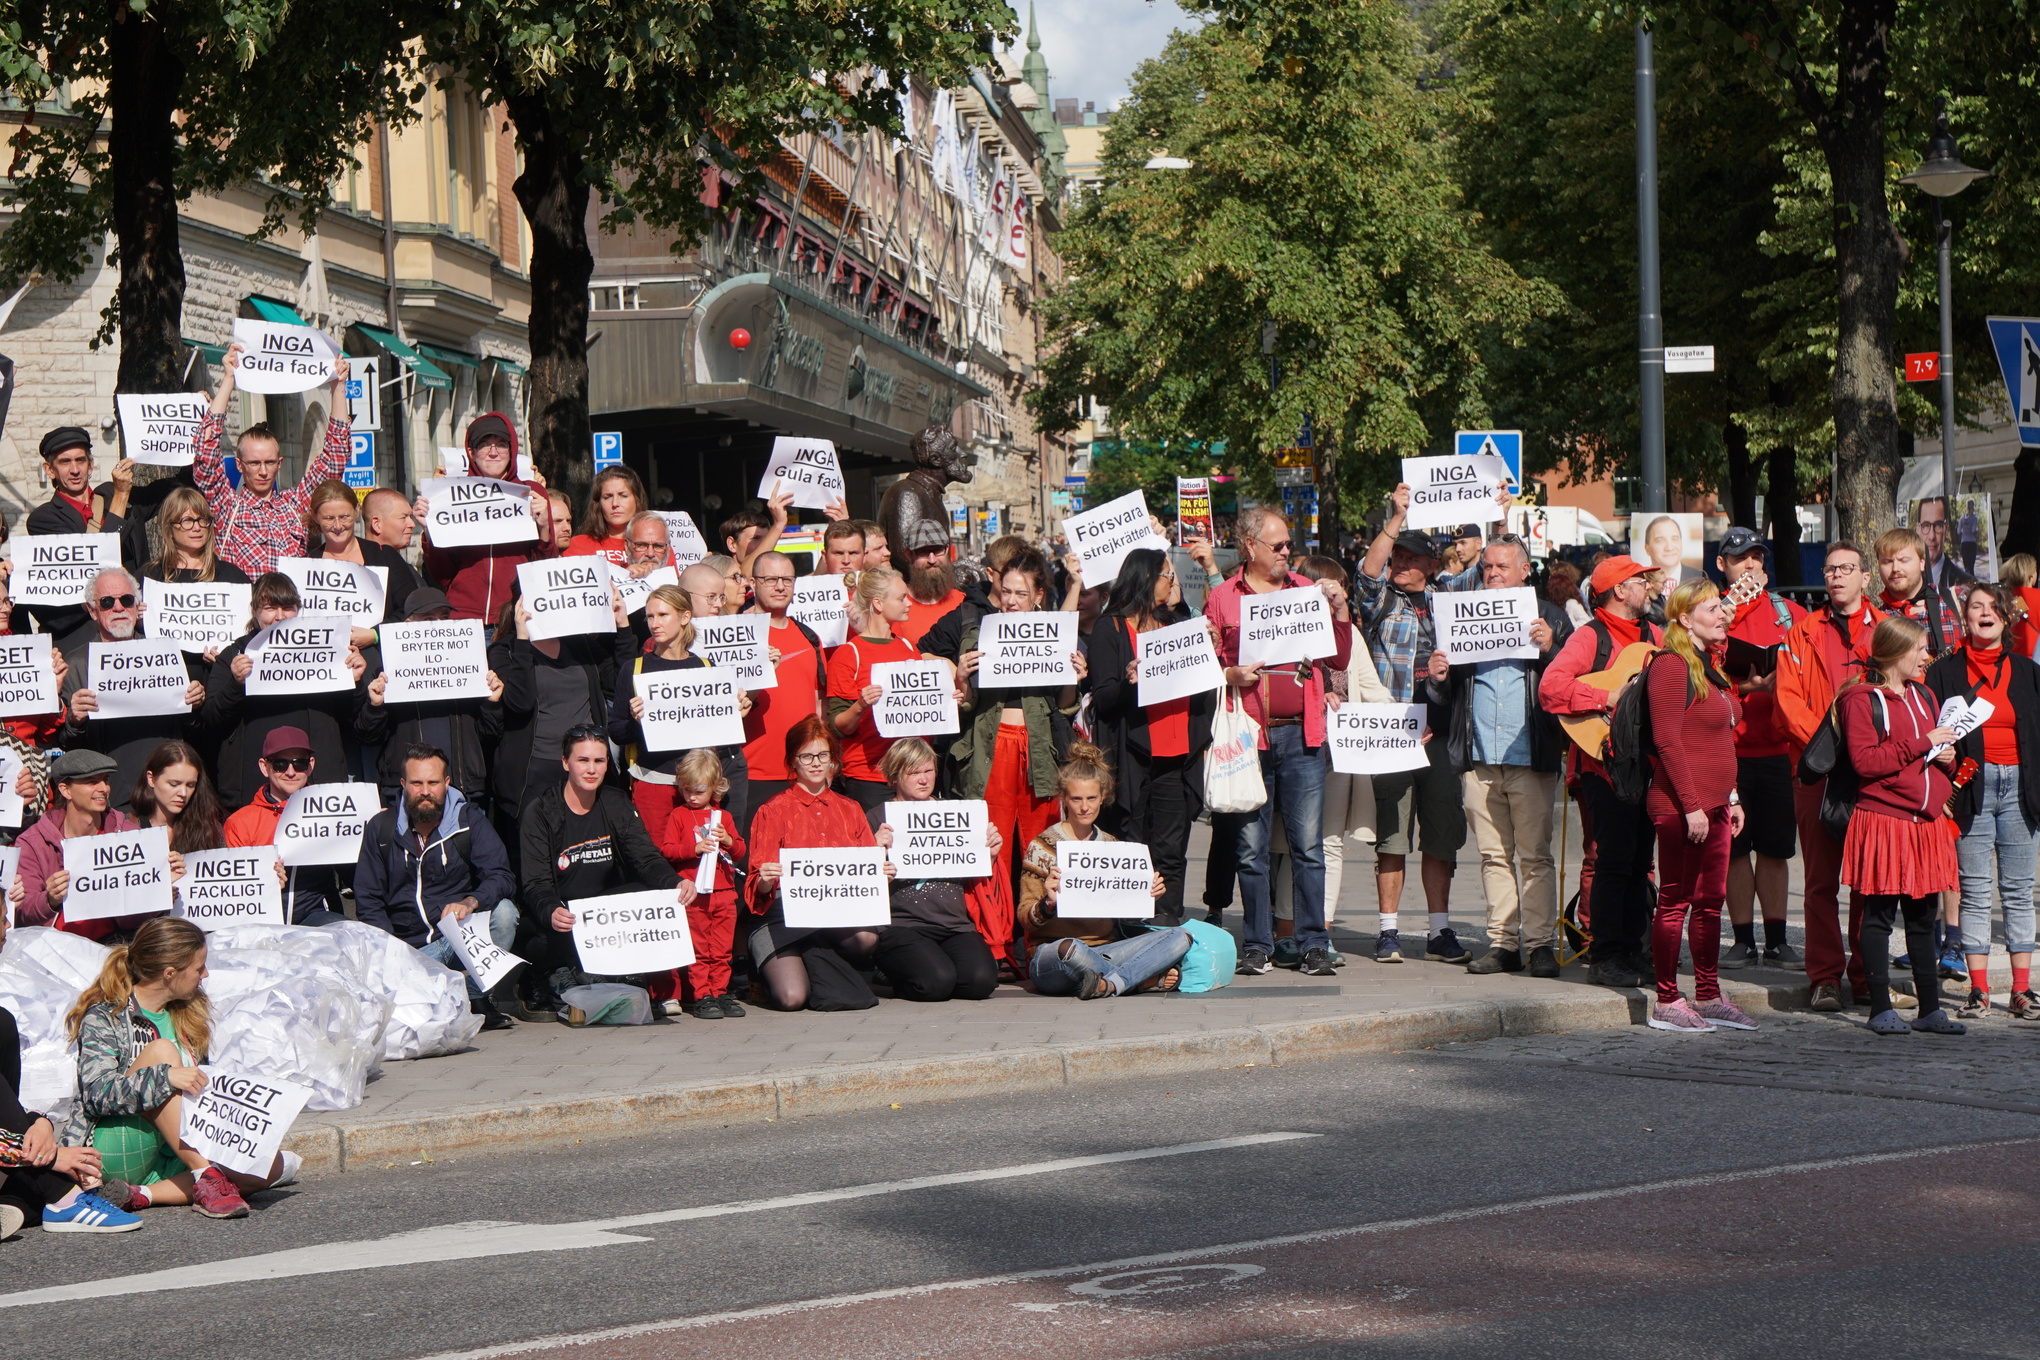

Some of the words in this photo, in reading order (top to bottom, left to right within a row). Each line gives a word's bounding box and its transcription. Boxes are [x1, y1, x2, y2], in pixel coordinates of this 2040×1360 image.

[262, 333, 314, 353] INGA
[1667, 350, 1705, 359] Vasagatan
[242, 355, 284, 374] Gula
[290, 358, 329, 377] fack
[1914, 359, 1934, 374] 7.9
[141, 404, 205, 419] INGEN
[147, 424, 198, 437] AVTALS
[140, 439, 196, 454] SHOPPI
[794, 449, 835, 467] INGA
[348, 471, 370, 480] Avgift
[774, 465, 813, 484] Gula
[817, 472, 842, 490] fack
[1430, 465, 1477, 482] INGA
[451, 482, 505, 502] INGA
[1414, 488, 1451, 504] Gula
[1457, 485, 1492, 500] fack
[435, 510, 478, 526] Gula
[484, 504, 524, 522] fack
[1075, 504, 1144, 542] Försvara
[1082, 524, 1151, 560] strejkrätten
[33, 545, 98, 563] INGET
[306, 571, 357, 588] INGA
[548, 568, 597, 587] INGA
[26, 585, 84, 596] MONOP
[791, 590, 841, 604] rsvara
[164, 594, 230, 608] INGET
[300, 597, 329, 610] ula
[335, 597, 373, 613] fack
[533, 597, 577, 612] Gula
[582, 593, 610, 608] fack
[1454, 599, 1517, 618] INGET
[1250, 600, 1320, 620] Försvara
[159, 613, 236, 626] FACKLIGT
[159, 628, 235, 642] MONOPOL
[268, 629, 334, 645] INGET
[395, 630, 421, 639] LO:S
[424, 626, 474, 638] FÖRSLAG
[704, 625, 755, 644] INGEN
[998, 623, 1058, 639] INGEN
[1248, 620, 1324, 641] strejkrätten
[1450, 622, 1523, 636] FACKLIGT
[401, 640, 444, 652] BRYTER
[448, 640, 469, 650] MOT
[1000, 646, 1057, 657] AVTALS-
[1145, 631, 1204, 658] Försvara
[1450, 637, 1526, 653] MONOPOL
[0, 647, 33, 664] GET
[100, 653, 179, 670] Försvara
[262, 652, 336, 664] FACKLIGT
[425, 654, 442, 664] ILO
[707, 649, 757, 665] AVTALS-
[395, 665, 479, 677] KONVENTIONEN
[736, 665, 763, 678] PING
[993, 662, 1064, 674] SHOPPING
[1145, 652, 1209, 679] strejkrätten
[0, 671, 40, 684] KLIGT
[98, 674, 184, 692] strejkrätten
[259, 669, 338, 681] MONOPOL
[891, 672, 939, 688] INGET
[408, 680, 452, 690] ARTIKEL
[456, 678, 468, 687] 87
[648, 682, 732, 700] Försvara
[0, 689, 44, 702] NOPOL
[886, 694, 944, 707] FACKLIGT
[648, 704, 733, 724] strejkrätten
[885, 710, 946, 724] MONOPOL
[1337, 713, 1418, 730] Försvara
[1336, 736, 1417, 752] strejkrätten
[303, 796, 357, 813] INGA
[907, 812, 969, 828] INGEN
[285, 823, 329, 838] Gula
[909, 836, 969, 847] AVTALS-
[94, 843, 145, 866] INGA
[571, 854, 579, 863] IF
[902, 851, 976, 866] SHOPPING
[1067, 852, 1148, 869] Försvara
[195, 859, 259, 879] INGET
[789, 861, 877, 877] Försvara
[75, 873, 120, 892] Gula
[125, 867, 161, 887] fack
[1065, 877, 1148, 893] strejkrätten
[190, 884, 265, 899] FACKLIGT
[789, 883, 880, 899] strejkrätten
[187, 902, 267, 918] MONOPOL
[582, 904, 676, 927] Försvara
[584, 927, 680, 950] strejkrätten
[212, 1075, 282, 1108] INGET
[198, 1097, 272, 1135] FACKLIGT
[189, 1114, 258, 1159] MONOPOL
